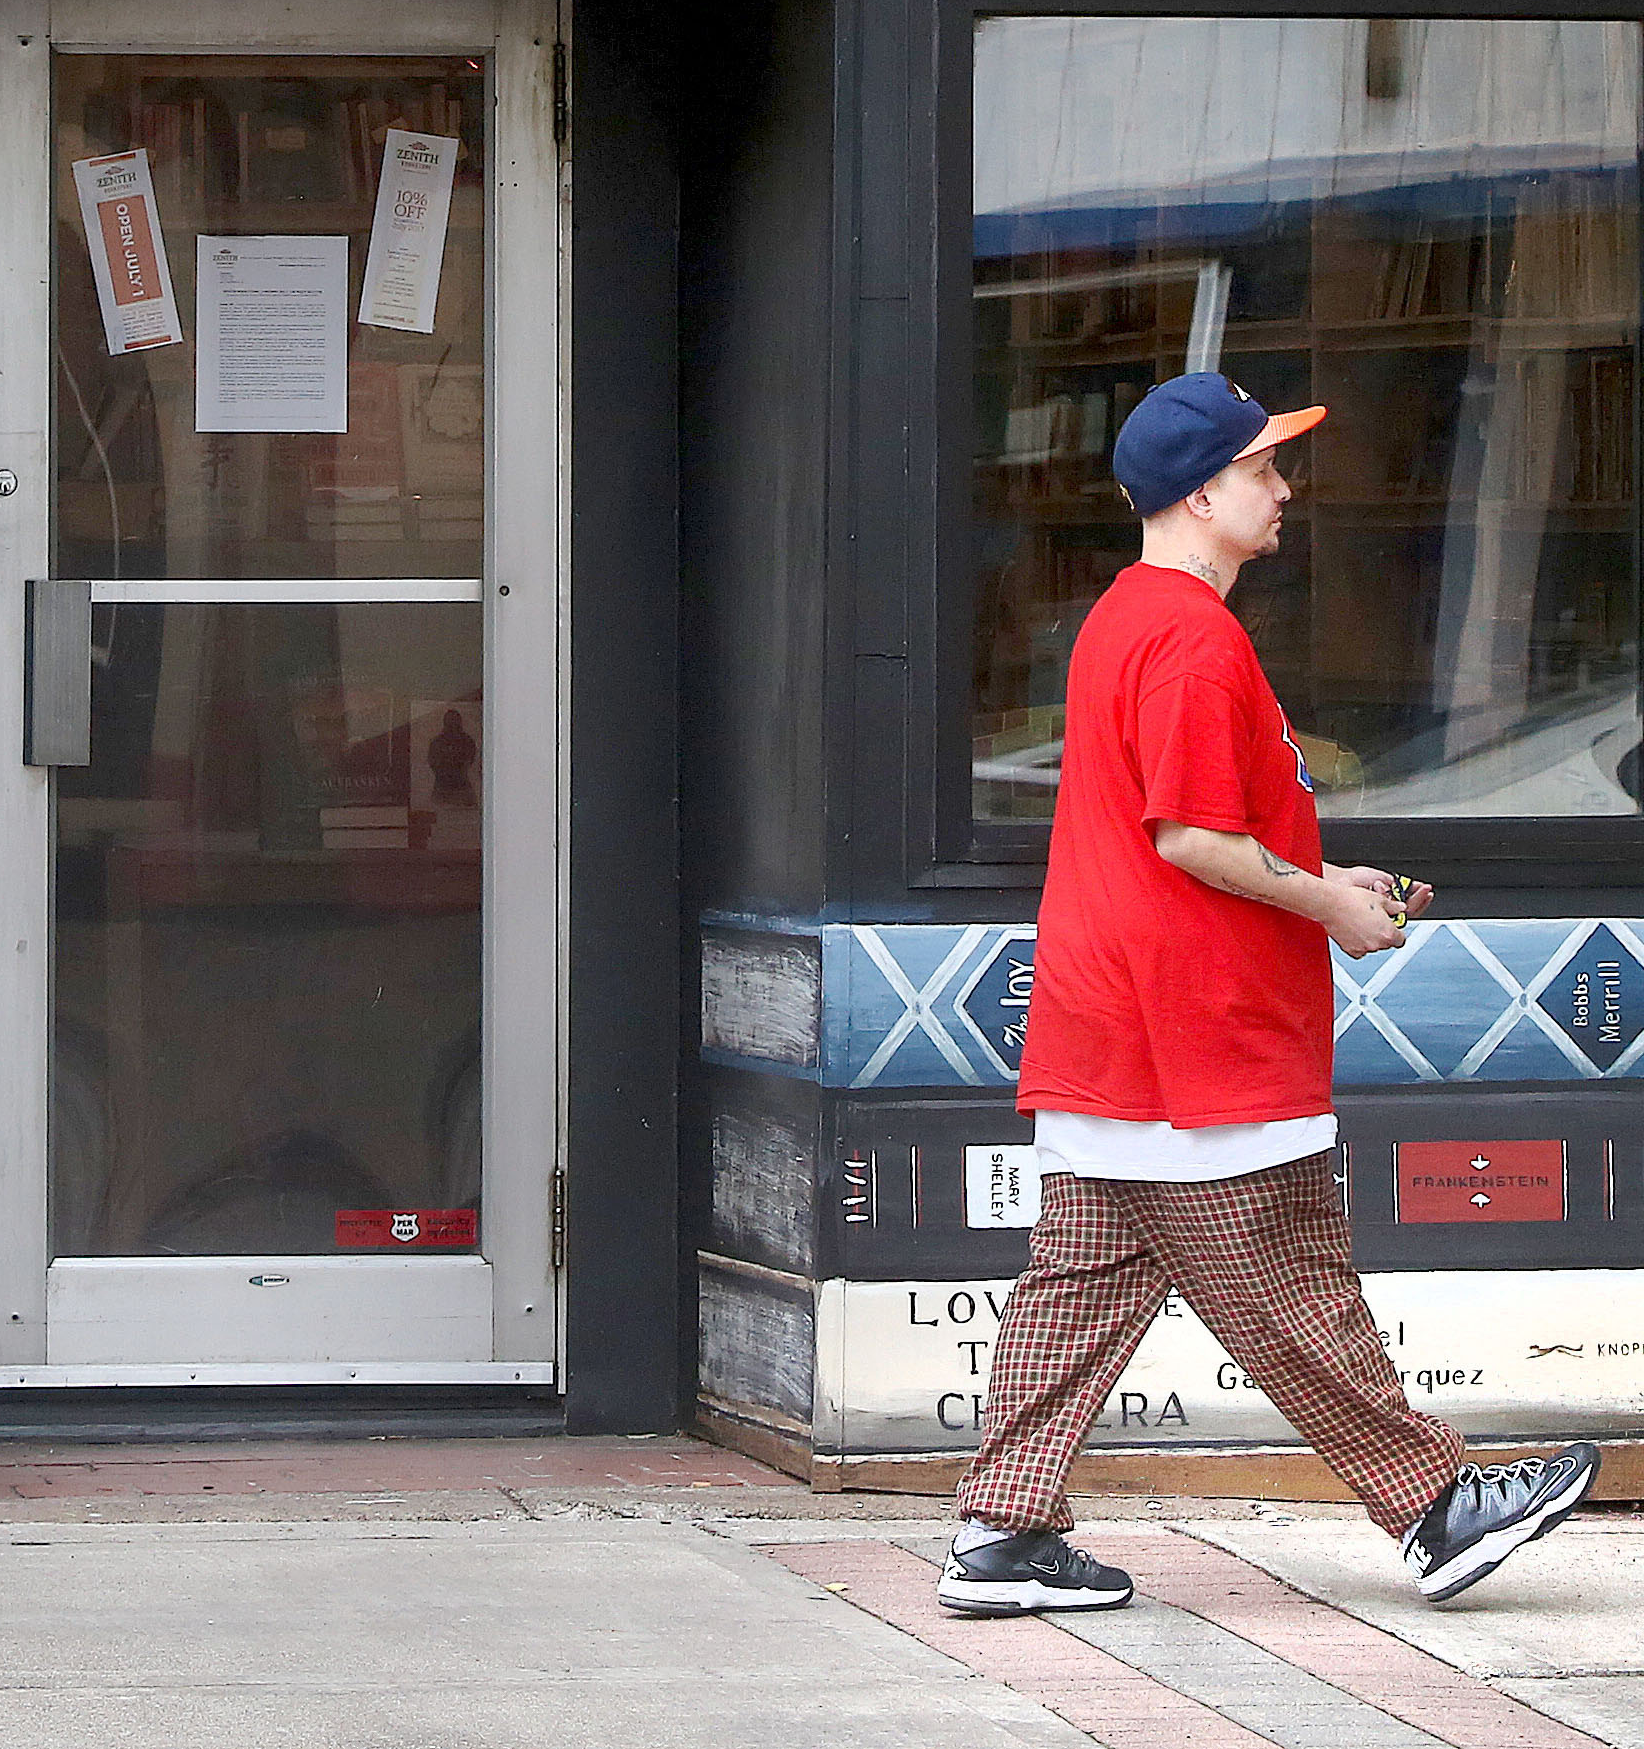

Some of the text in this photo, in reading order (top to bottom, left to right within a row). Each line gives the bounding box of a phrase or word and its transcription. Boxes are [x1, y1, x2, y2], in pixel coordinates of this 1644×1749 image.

[397, 148, 439, 165] ZENITH
[96, 171, 137, 188] ZENITH
[396, 190, 428, 206] 10%
[115, 202, 135, 247] OPEN
[394, 203, 428, 220] OFF
[123, 250, 143, 288] JULY
[1572, 971, 1590, 1027] Bobbs
[1596, 960, 1621, 1043] Merrill
[991, 1153, 1004, 1221] SHELLEY
[1008, 1166, 1020, 1207] MARY
[1412, 1174, 1550, 1189] FRANKENSTEIN
[907, 1290, 1014, 1328] LOV
[1398, 1367, 1484, 1394] rquez
